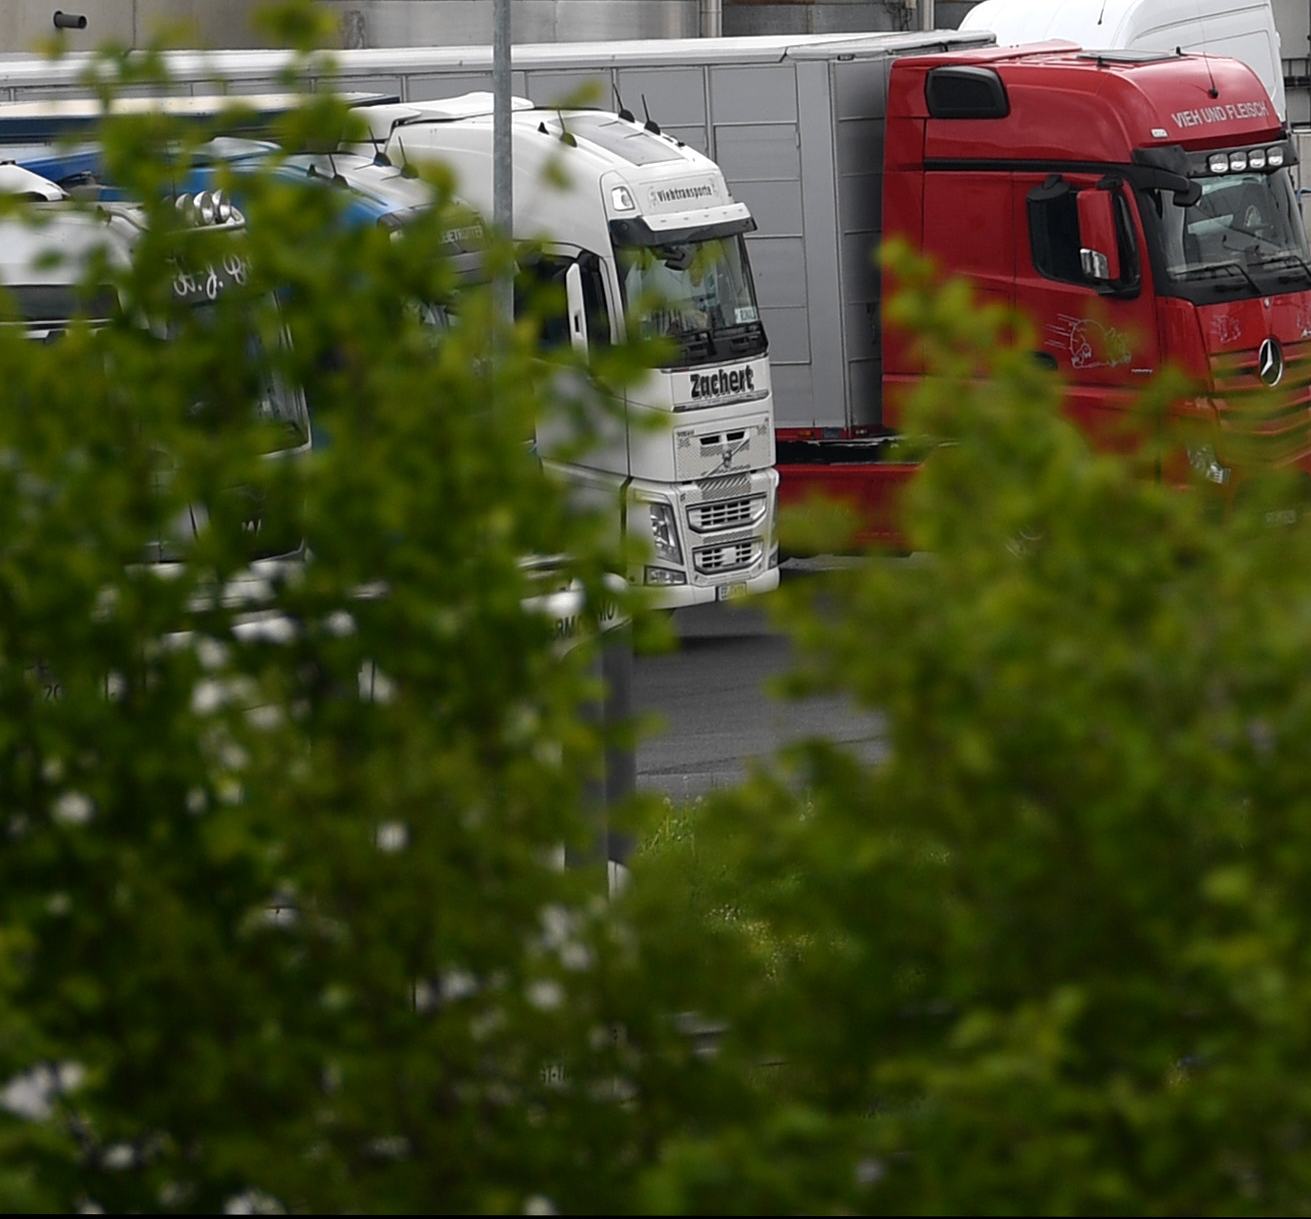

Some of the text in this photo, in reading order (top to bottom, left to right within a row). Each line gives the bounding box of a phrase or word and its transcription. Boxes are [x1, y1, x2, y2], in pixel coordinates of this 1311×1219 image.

[1171, 102, 1270, 128] VIEH UND FLEISCH
[690, 365, 755, 399] Zachert
